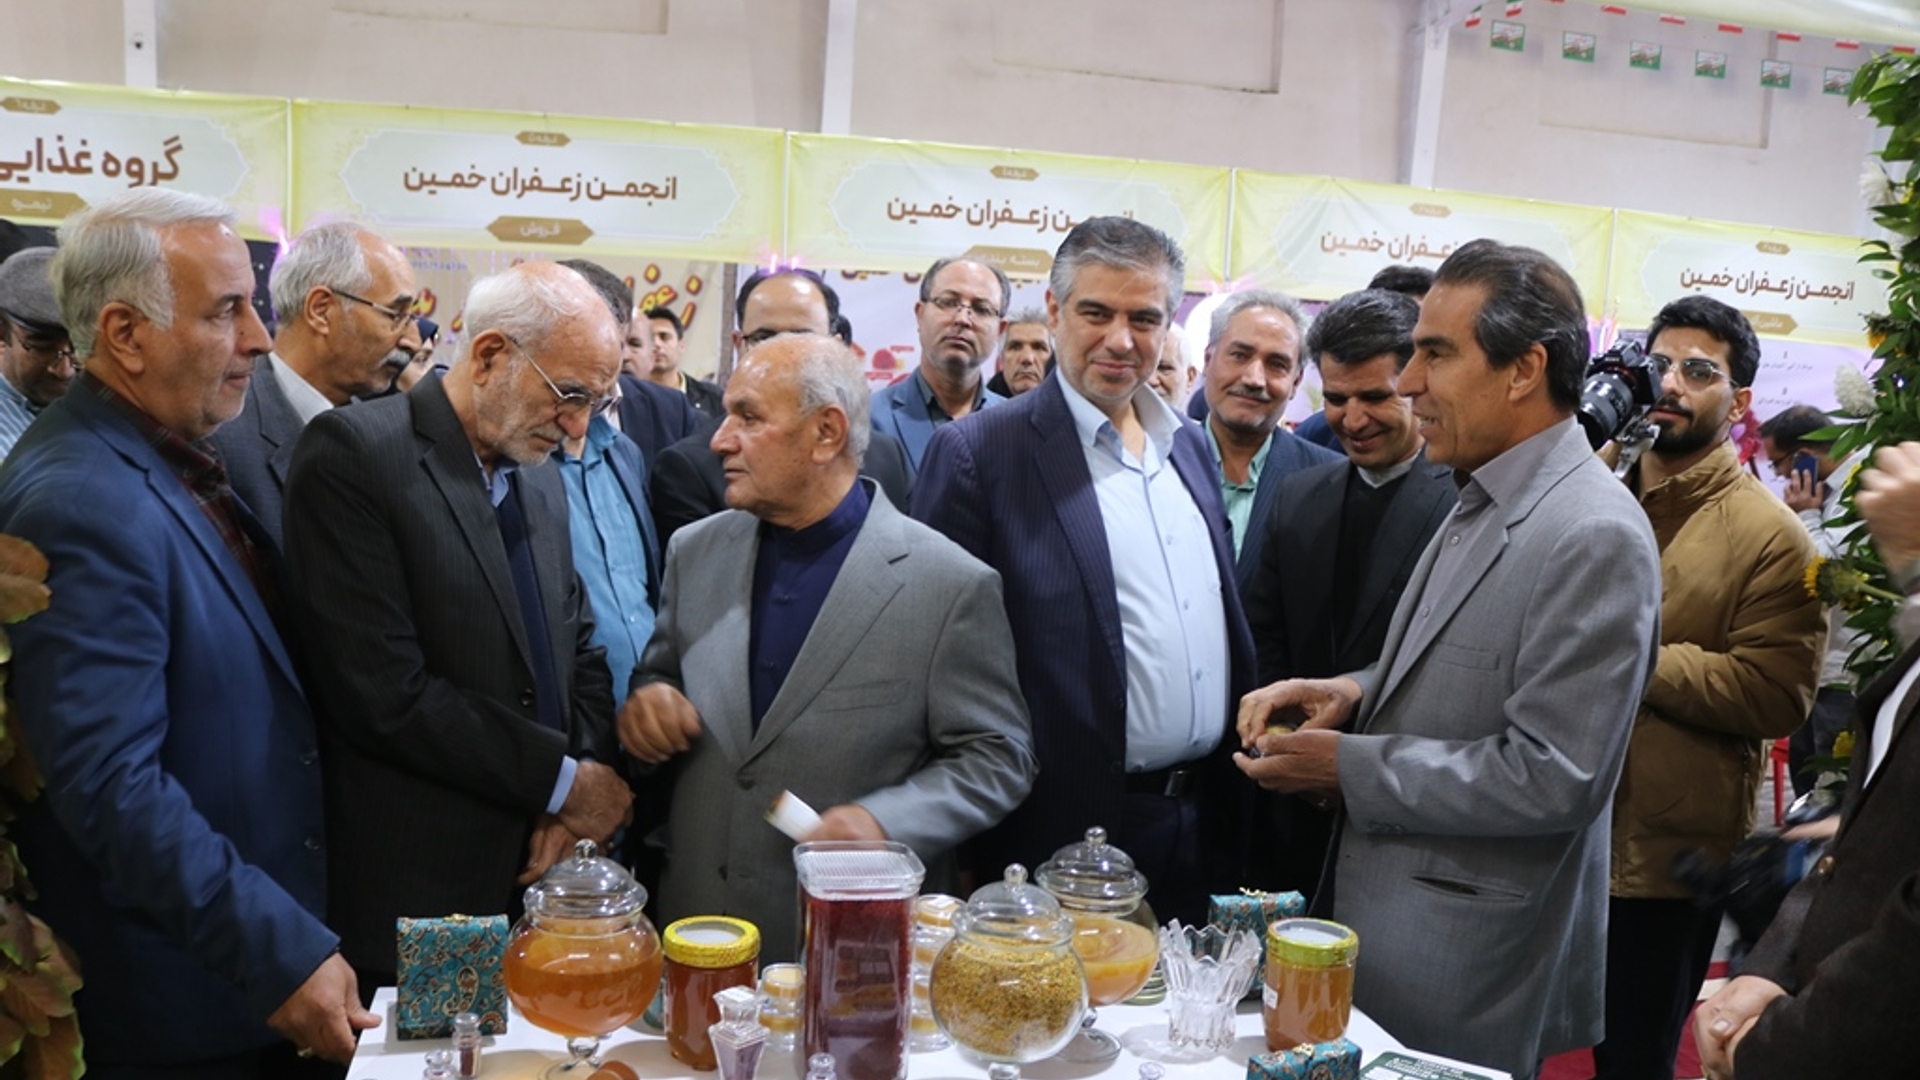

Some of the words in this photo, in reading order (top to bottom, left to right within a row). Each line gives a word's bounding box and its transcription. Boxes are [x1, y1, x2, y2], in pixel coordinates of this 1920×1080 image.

[101, 135, 183, 188] گروه
[403, 165, 486, 195] خمین
[491, 167, 581, 202] زعفران
[586, 176, 678, 207] انجمن
[886, 196, 962, 225] خمین
[966, 199, 1048, 233] زعفران
[520, 221, 560, 238] فروش
[1320, 230, 1385, 257] خمین
[1680, 267, 1733, 292] خمین
[1735, 270, 1795, 300] زعفران
[1796, 280, 1856, 306] انجمن
